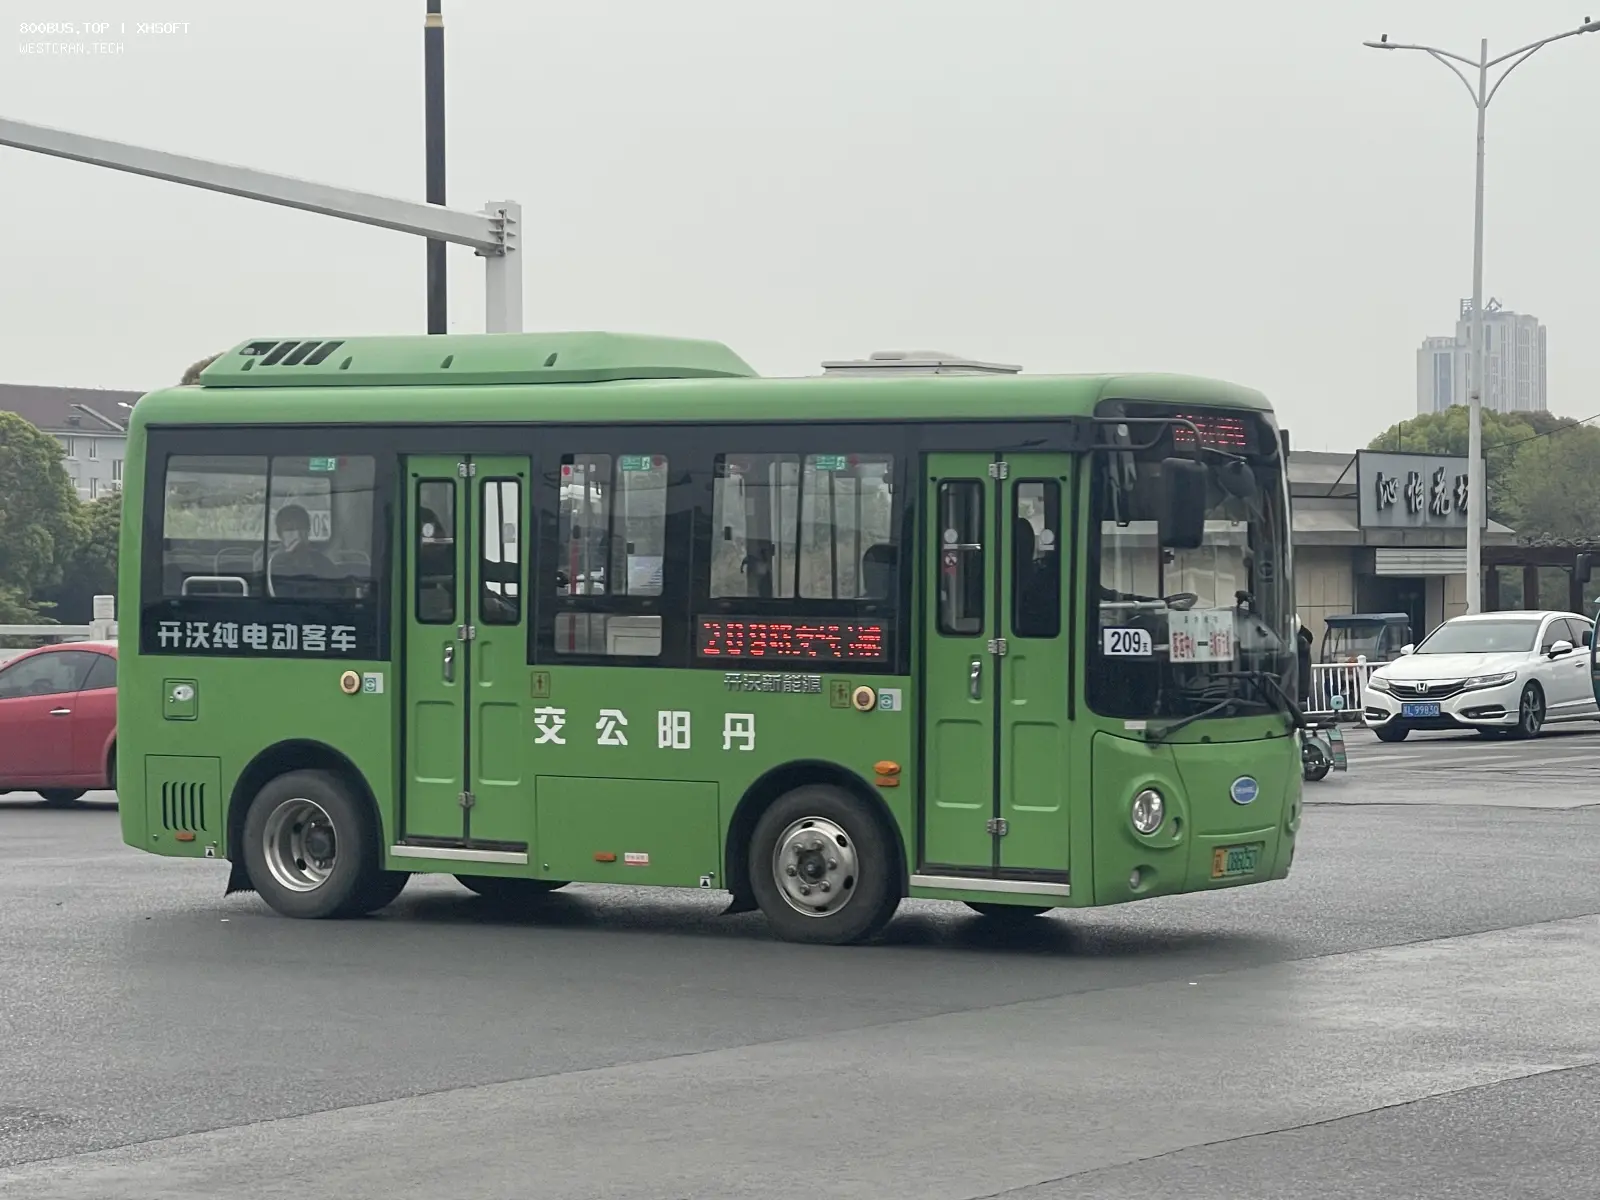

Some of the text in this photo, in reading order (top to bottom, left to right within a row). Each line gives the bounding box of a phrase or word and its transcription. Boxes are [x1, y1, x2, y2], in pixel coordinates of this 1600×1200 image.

[157, 620, 356, 651] 开沃纯电动客车
[723, 672, 822, 693] 开沃新能源
